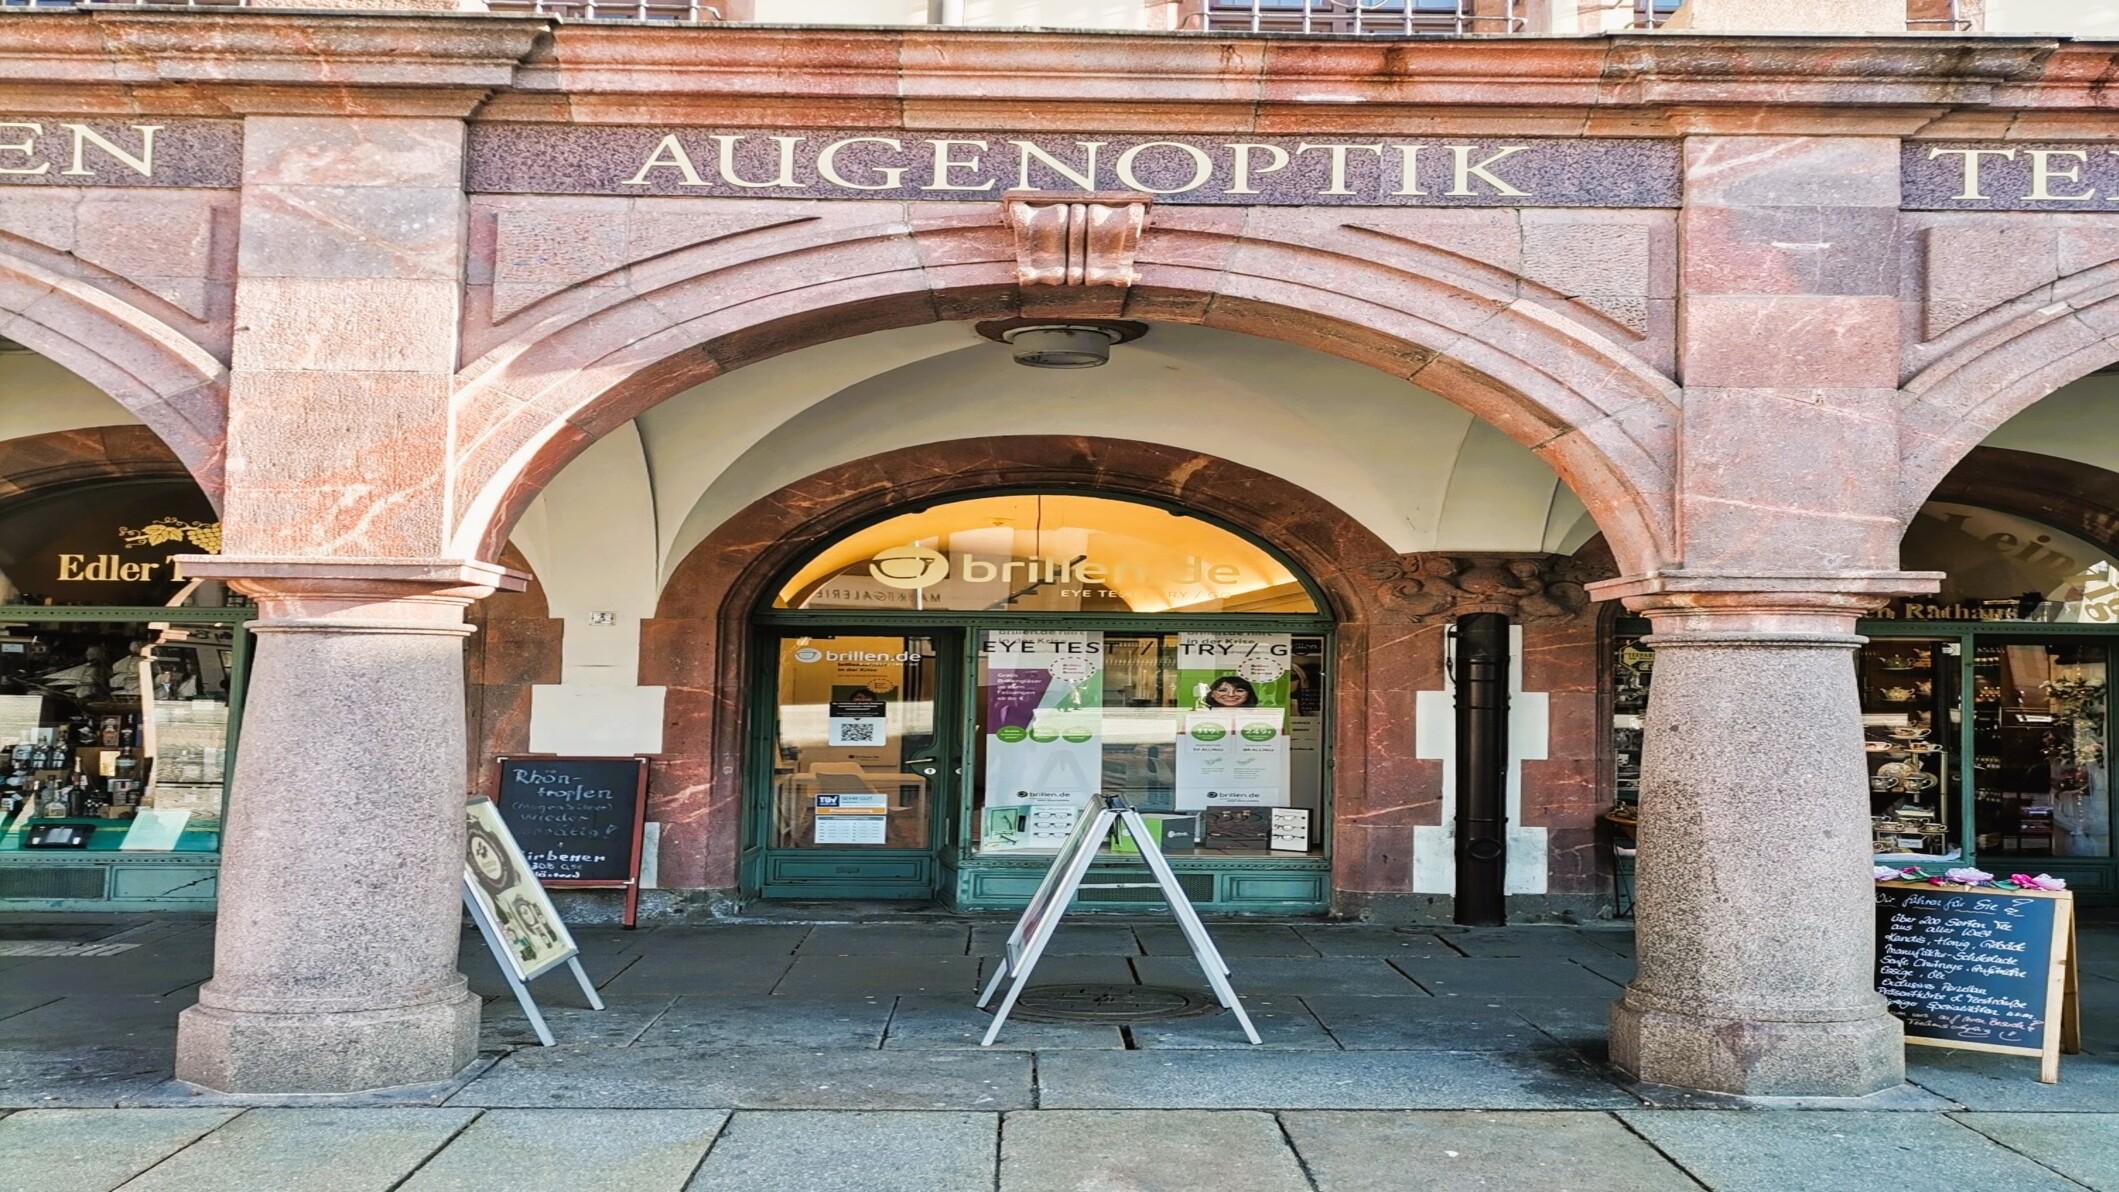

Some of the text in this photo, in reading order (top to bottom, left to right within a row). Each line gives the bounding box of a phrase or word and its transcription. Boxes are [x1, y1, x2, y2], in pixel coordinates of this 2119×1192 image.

[620, 132, 1533, 198] AUGENOPTIK
[1927, 147, 2119, 202] TE
[57, 553, 204, 582] Edler T
[963, 554, 1240, 584] brillende
[1061, 589, 1091, 598] EYE
[1905, 602, 2018, 620] Rathaus
[826, 650, 922, 662] brillen.de
[983, 641, 1035, 653] EYE
[1050, 642, 1121, 655] TEST
[1180, 643, 1234, 656] TRY
[1973, 898, 1999, 911] Sie
[1918, 915, 1942, 925] 200
[1944, 918, 1987, 929] Sorten
[1993, 920, 2014, 931] Tee
